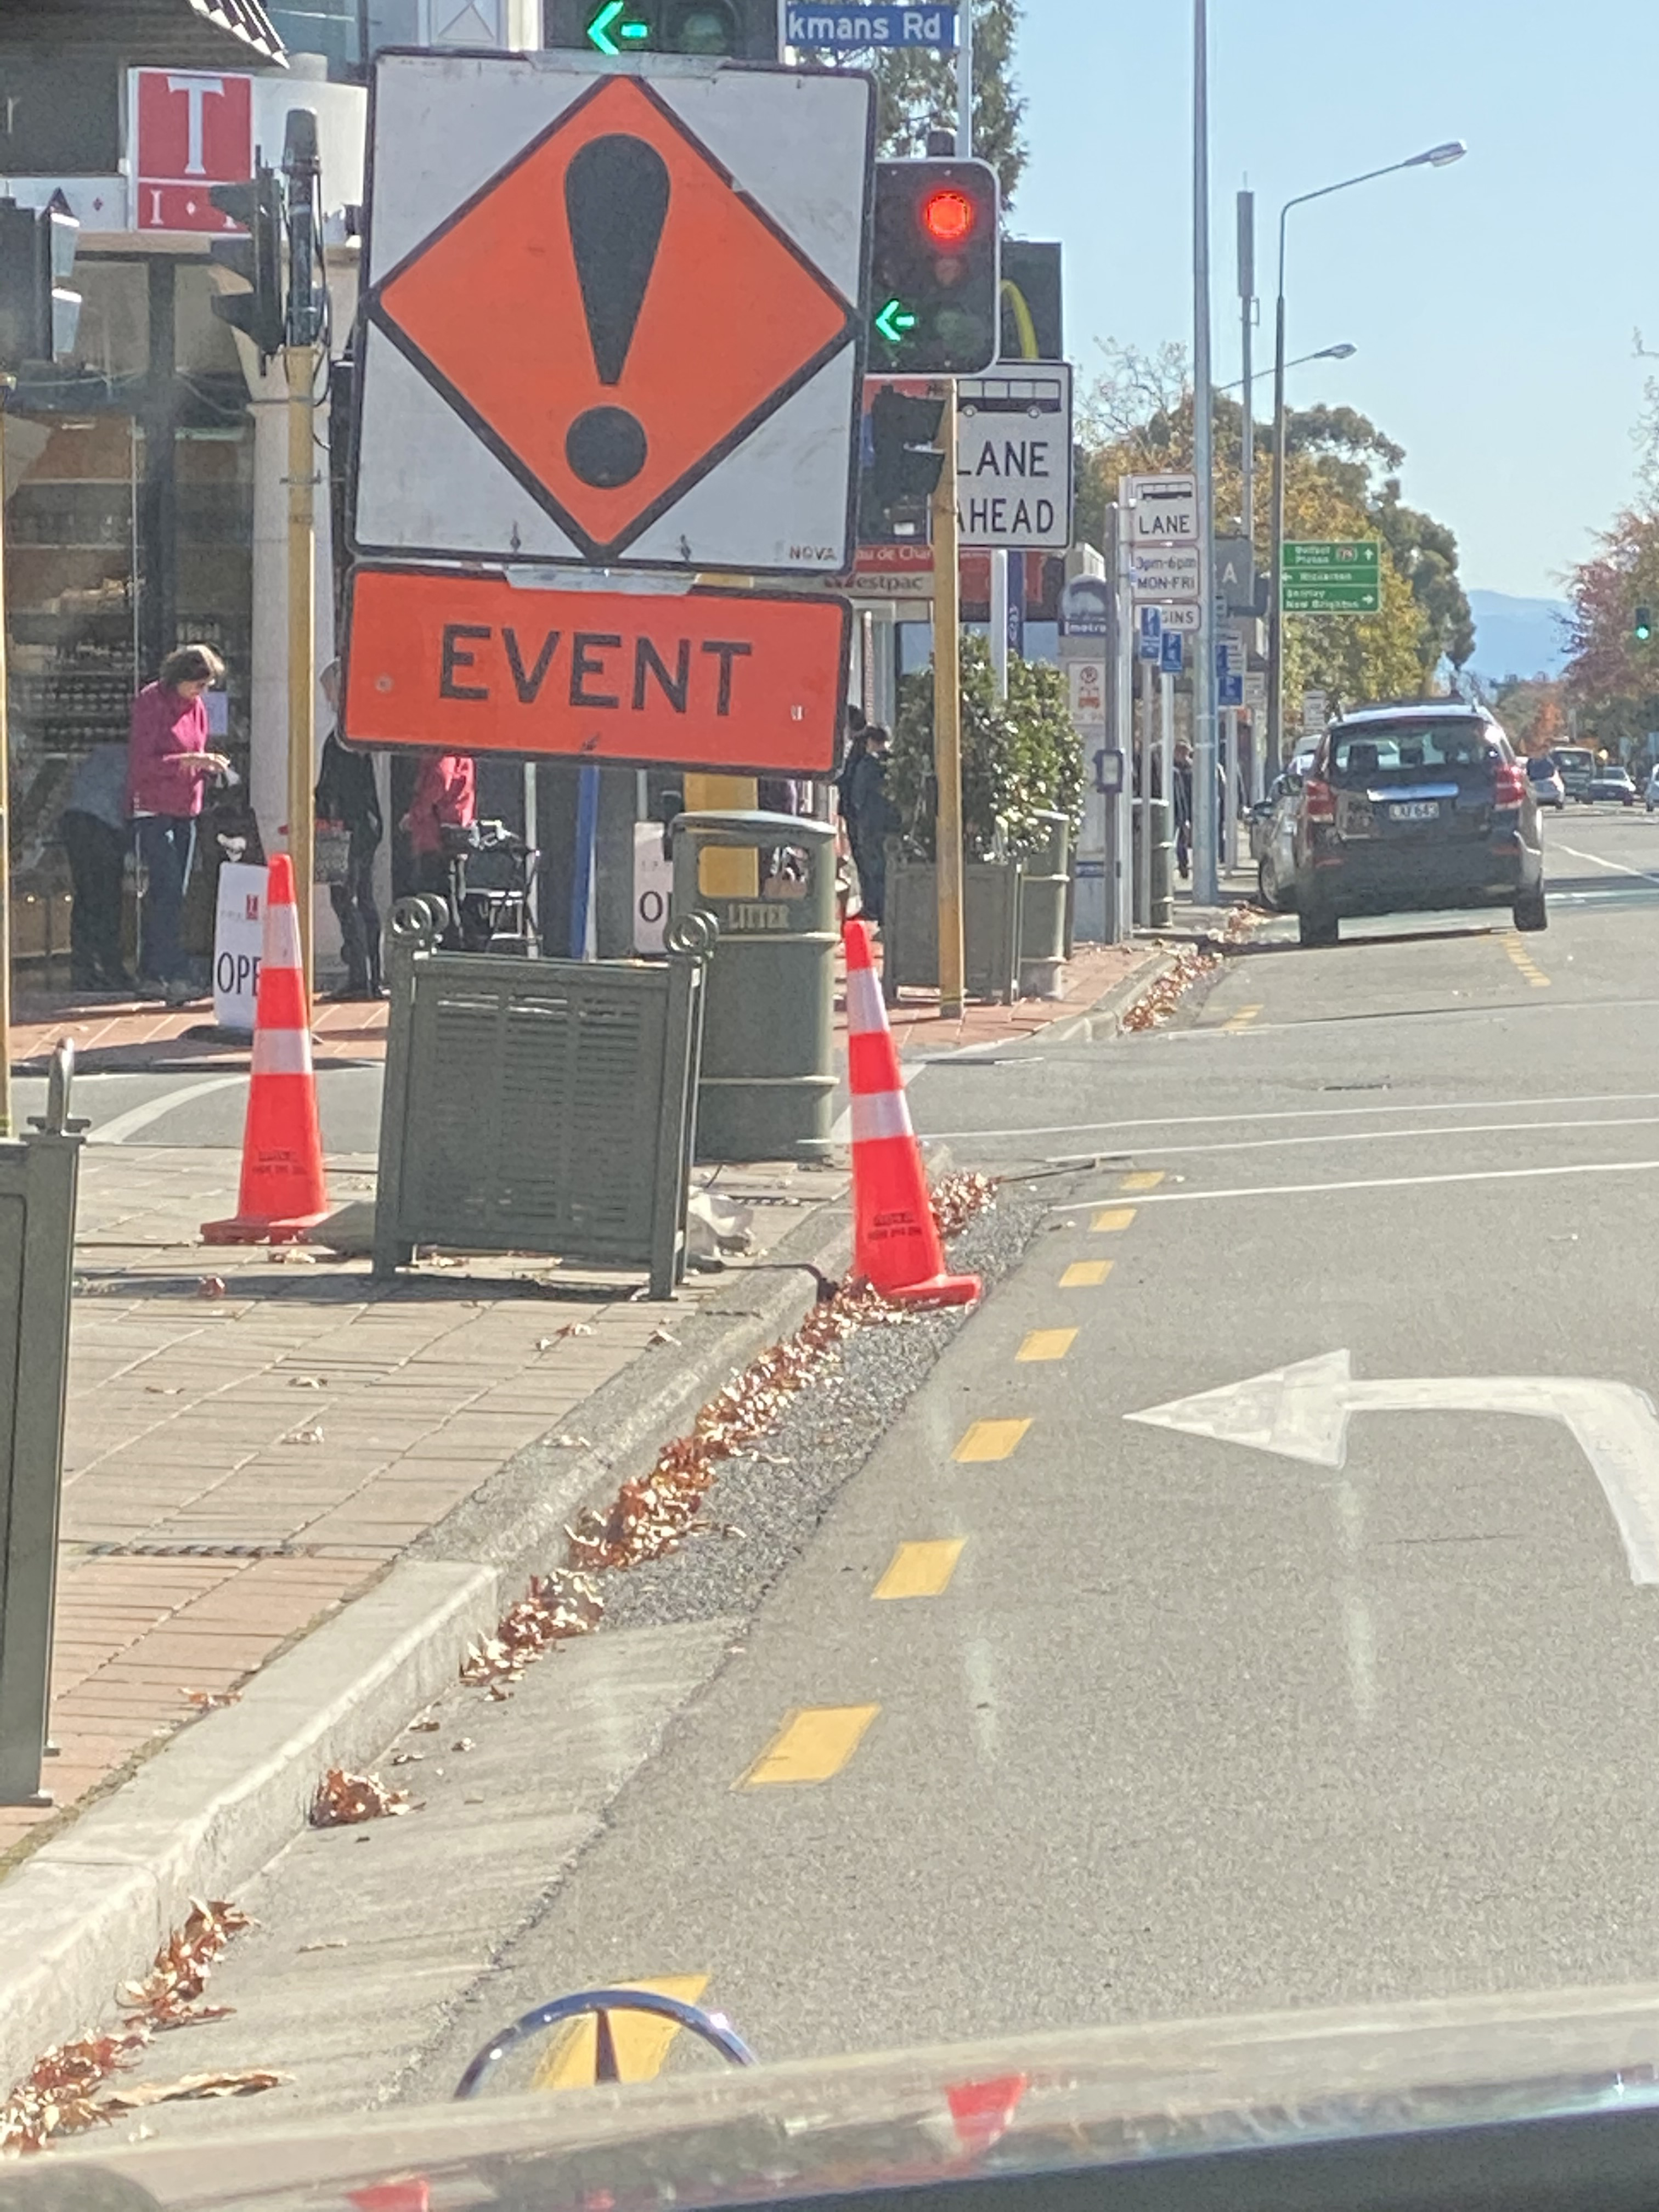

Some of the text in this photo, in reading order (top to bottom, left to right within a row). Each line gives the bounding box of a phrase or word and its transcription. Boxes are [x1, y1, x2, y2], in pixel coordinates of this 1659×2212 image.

[788, 11, 941, 40] kmans Rd
[167, 76, 224, 174] T
[1139, 514, 1190, 535] LANE
[789, 545, 837, 560] NOVA
[439, 624, 752, 716] EVENT
[727, 903, 790, 929] LITTER
